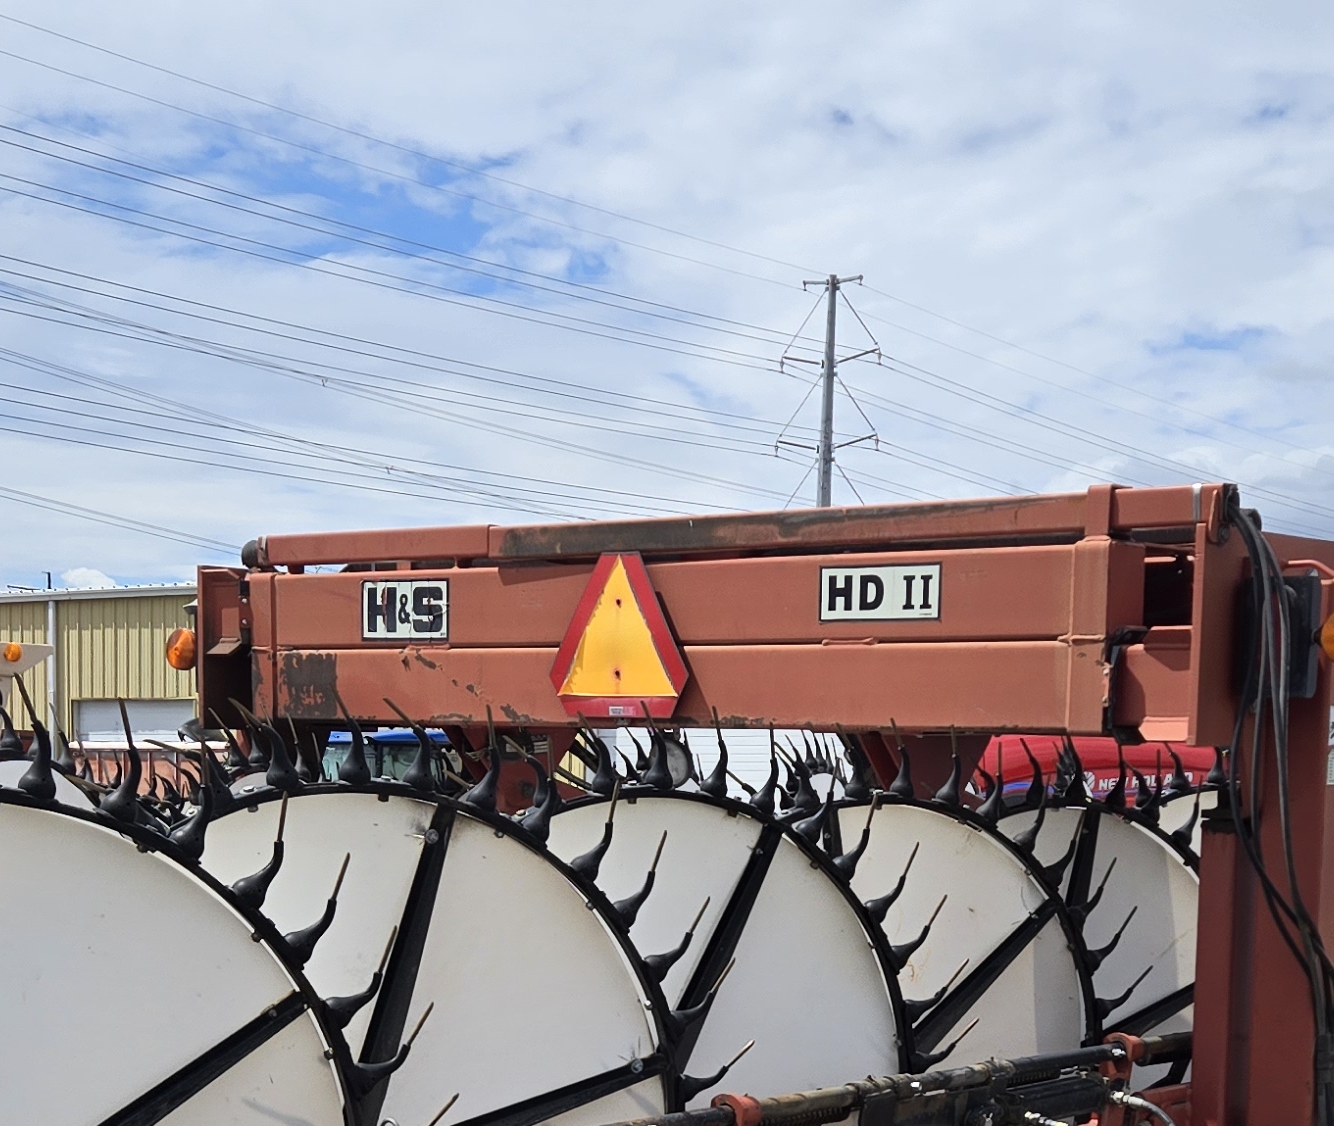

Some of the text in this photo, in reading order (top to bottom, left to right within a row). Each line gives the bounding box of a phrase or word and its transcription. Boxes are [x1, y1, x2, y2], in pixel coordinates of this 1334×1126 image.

[367, 587, 444, 633] H&S
[828, 574, 933, 612] HD II
